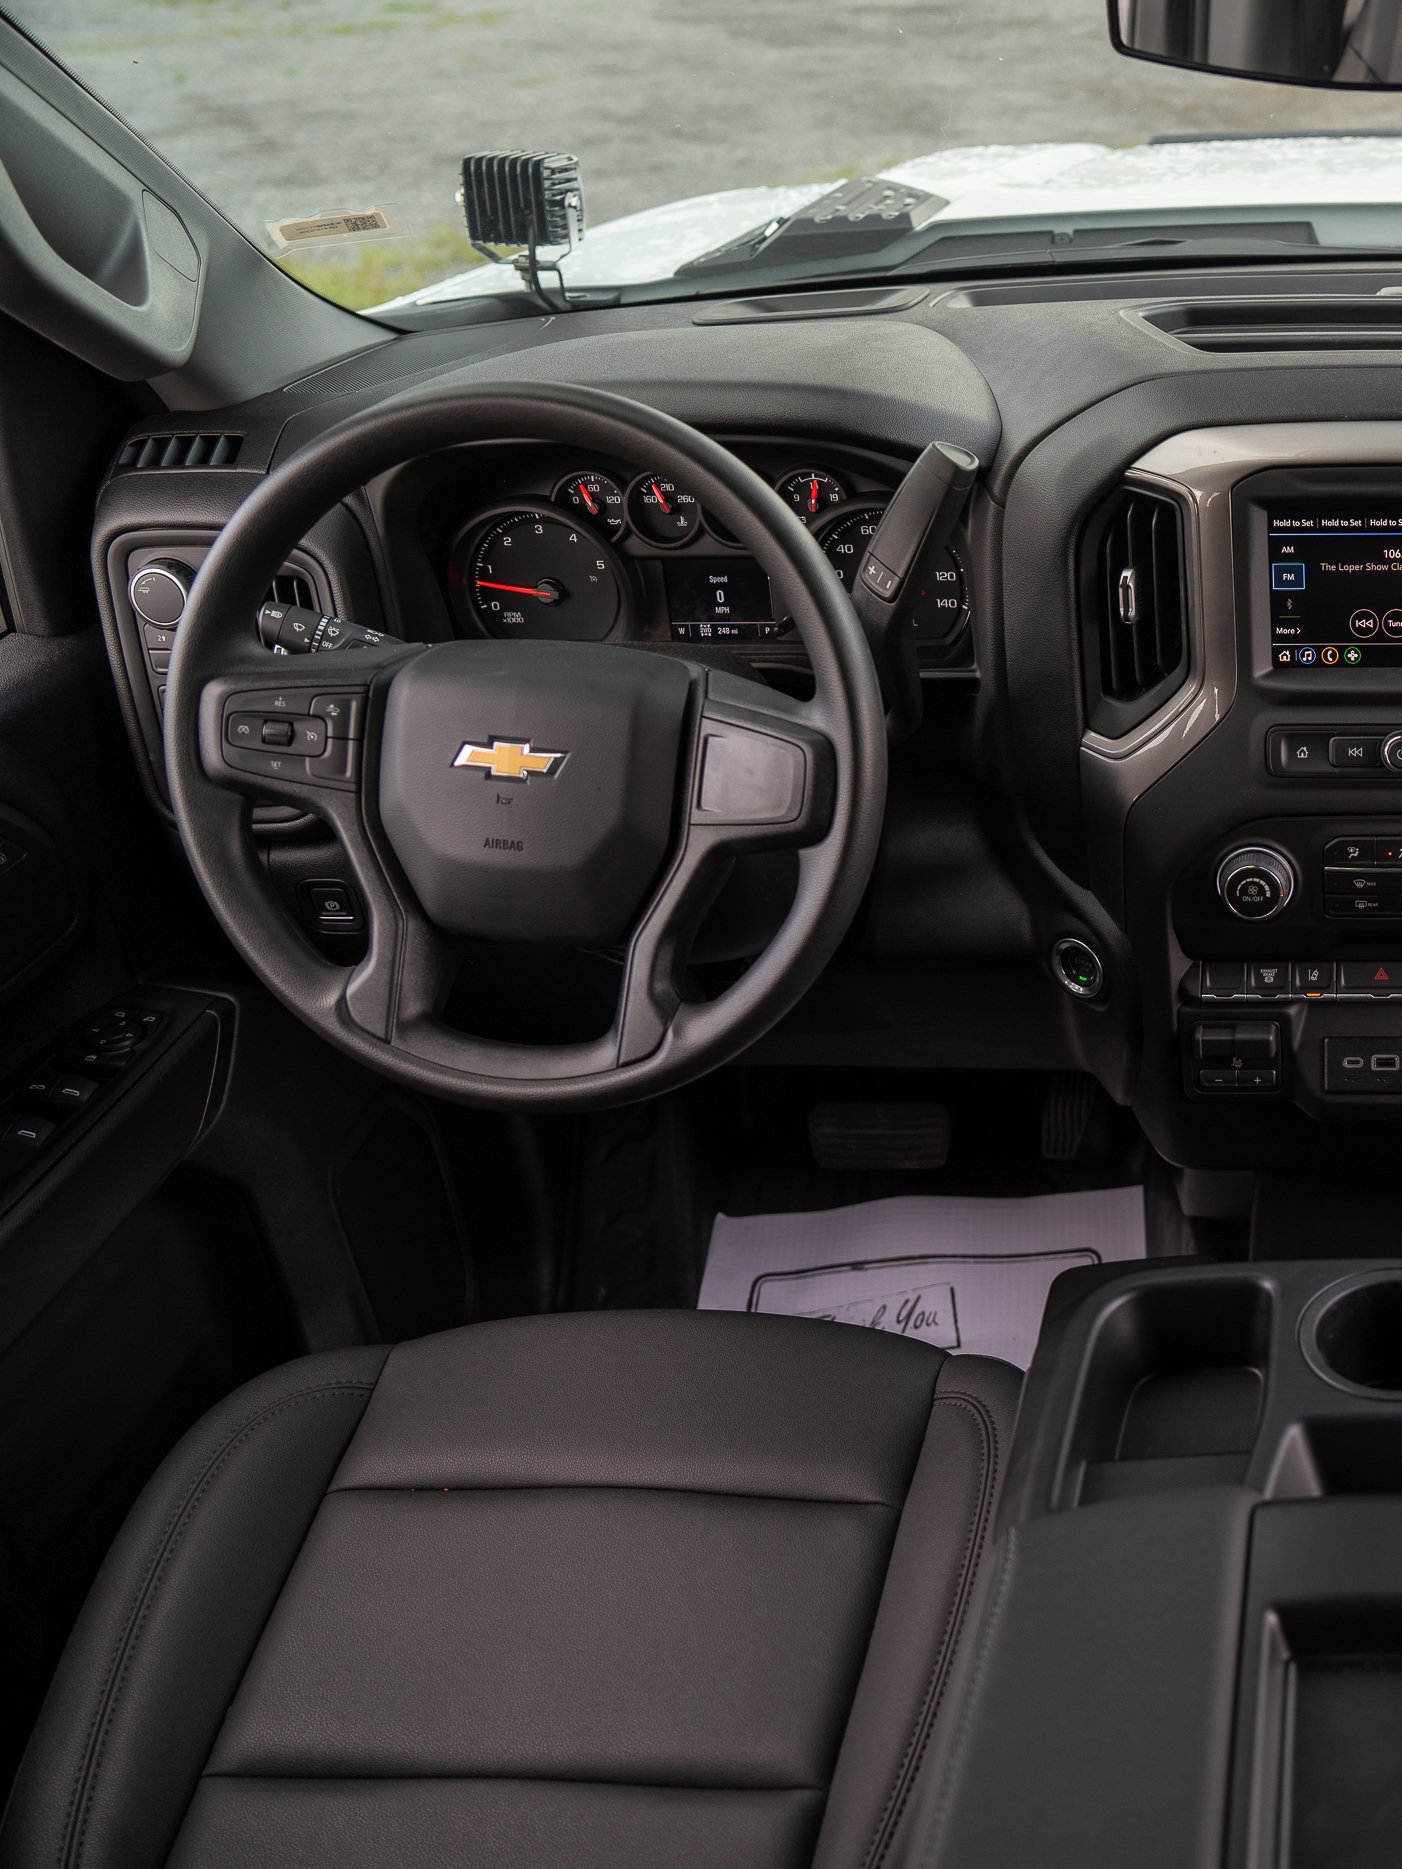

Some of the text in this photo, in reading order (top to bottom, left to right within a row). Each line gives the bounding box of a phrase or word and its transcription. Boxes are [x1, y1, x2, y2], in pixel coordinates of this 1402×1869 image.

[588, 484, 600, 492] 60
[660, 483, 675, 492] 210
[573, 496, 579, 504] 0
[606, 495, 621, 504] 120
[643, 495, 658, 503] 160
[677, 495, 695, 503] 260
[793, 494, 800, 502] 9
[829, 494, 839, 502] 19
[1273, 519, 1290, 527] Hold
[1301, 519, 1314, 527] Set
[1321, 519, 1339, 527] Hold
[1349, 519, 1362, 527] Set
[1370, 519, 1387, 527] Hold
[534, 524, 543, 534] 3
[860, 526, 877, 535] 60
[503, 536, 512, 546] 2
[569, 533, 578, 543] 4
[836, 544, 854, 554] 40
[1281, 546, 1295, 554] AM
[487, 564, 493, 574] 1
[596, 560, 605, 570] 5
[1320, 562, 1337, 571] The
[1338, 562, 1364, 573] Loper
[1365, 562, 1389, 571] Show
[709, 575, 728, 584] Speed
[935, 571, 956, 581] 120
[1282, 573, 1295, 581] FM
[716, 589, 725, 603] 0
[491, 601, 500, 611] 0
[936, 598, 957, 609] 140
[715, 606, 730, 614] MPH
[678, 627, 686, 635] W
[717, 627, 739, 635] 248 mi
[765, 627, 771, 635] P
[1276, 627, 1295, 635] More
[274, 700, 286, 708] RES
[483, 838, 524, 851] AIRBAG
[1242, 895, 1265, 903] ON/OFF
[896, 1294, 939, 1334] You
